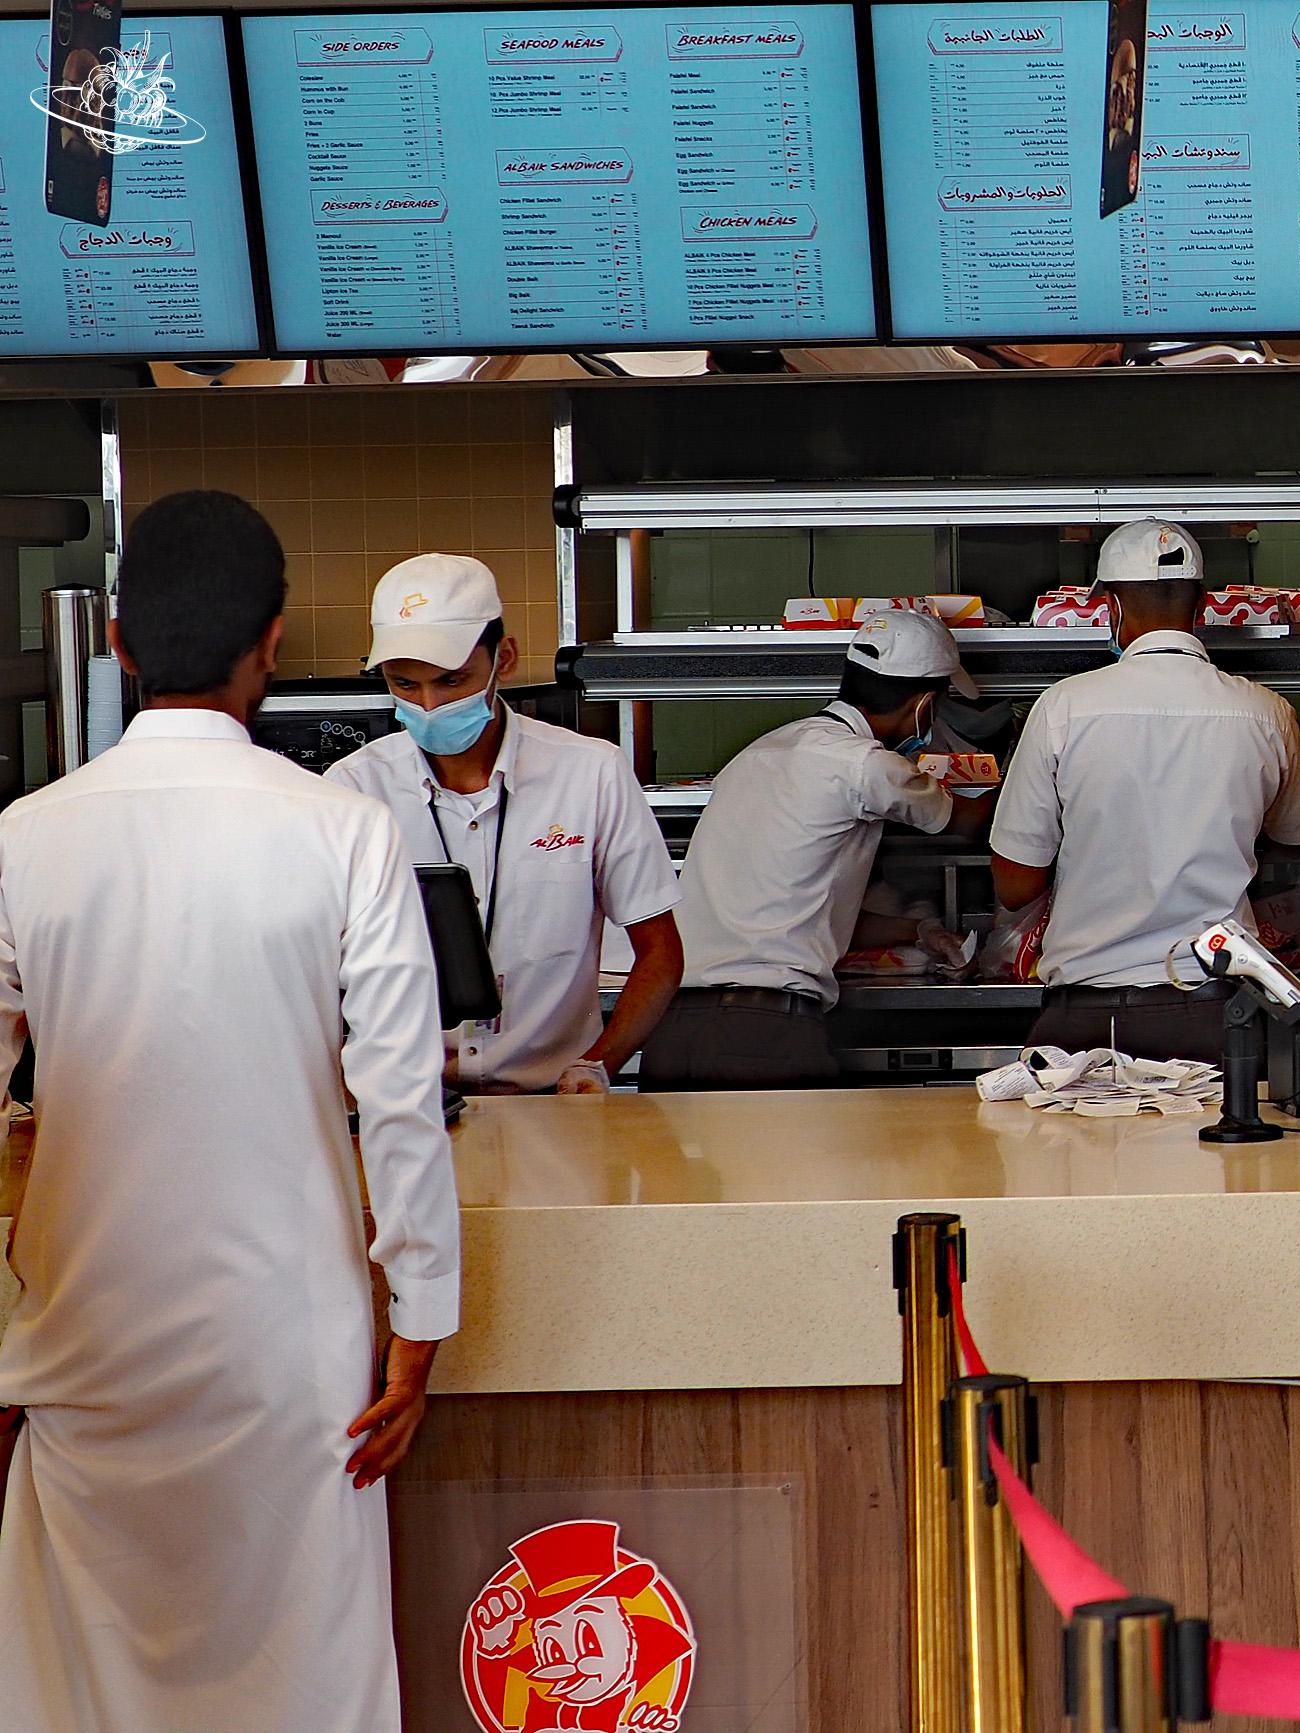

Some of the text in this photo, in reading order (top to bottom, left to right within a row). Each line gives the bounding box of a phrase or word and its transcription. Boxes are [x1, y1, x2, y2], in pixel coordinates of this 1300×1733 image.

[944, 28, 1045, 44] الطلبات الجانبية
[1179, 23, 1233, 41] الوجبات
[500, 38, 605, 50] SEAFOOD MEALS
[677, 34, 796, 46] BREAKFAST MEALS
[322, 42, 400, 52] SIDE ORDERS
[1171, 143, 1240, 160] سندوتشات
[504, 160, 624, 172] ALBAIK SANDWICHES
[1015, 185, 1066, 200] الحلويات
[321, 201, 372, 211] DESSERTS
[382, 199, 440, 211] BEVERAGES
[700, 217, 797, 229] CHICKEN MEALS
[79, 231, 172, 251] وجبات الدجاج
